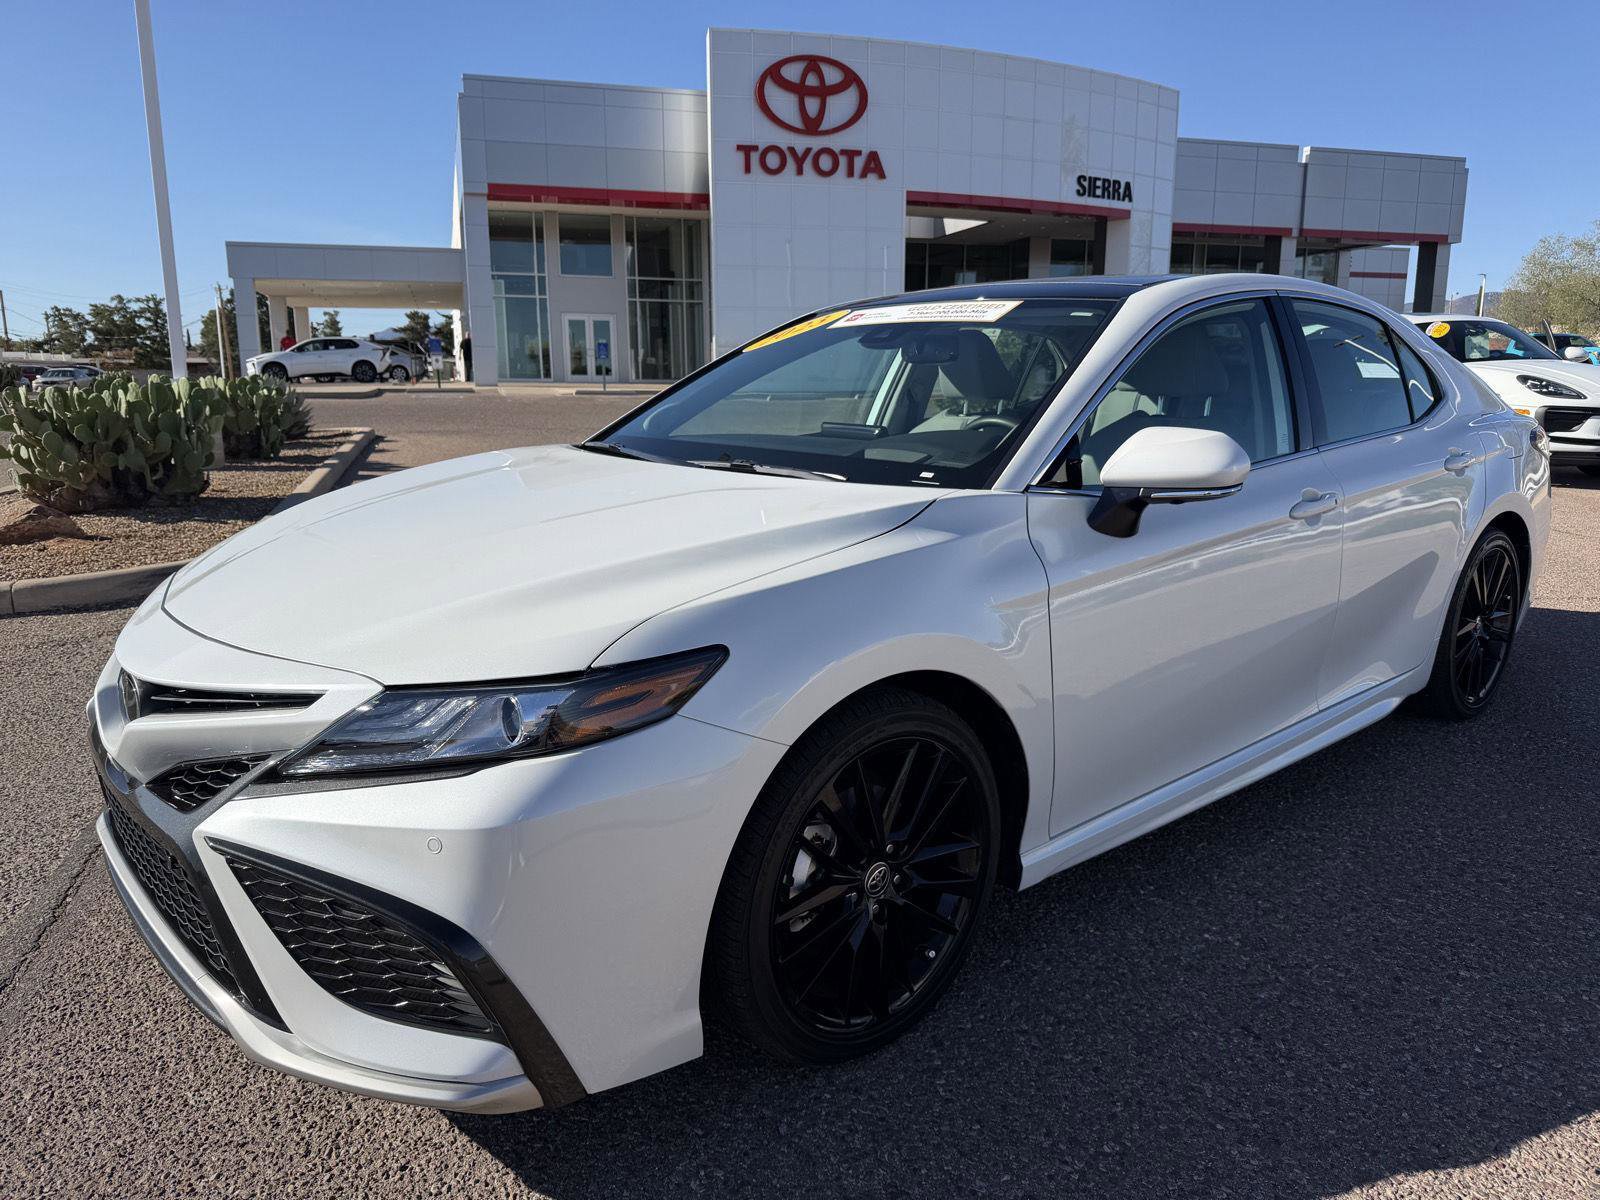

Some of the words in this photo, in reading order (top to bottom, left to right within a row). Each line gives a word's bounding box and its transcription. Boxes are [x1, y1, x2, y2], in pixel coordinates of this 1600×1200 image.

[736, 144, 887, 180] TOYOTA
[1076, 174, 1133, 203] SIERRA
[942, 303, 1006, 311] CERTIFIED
